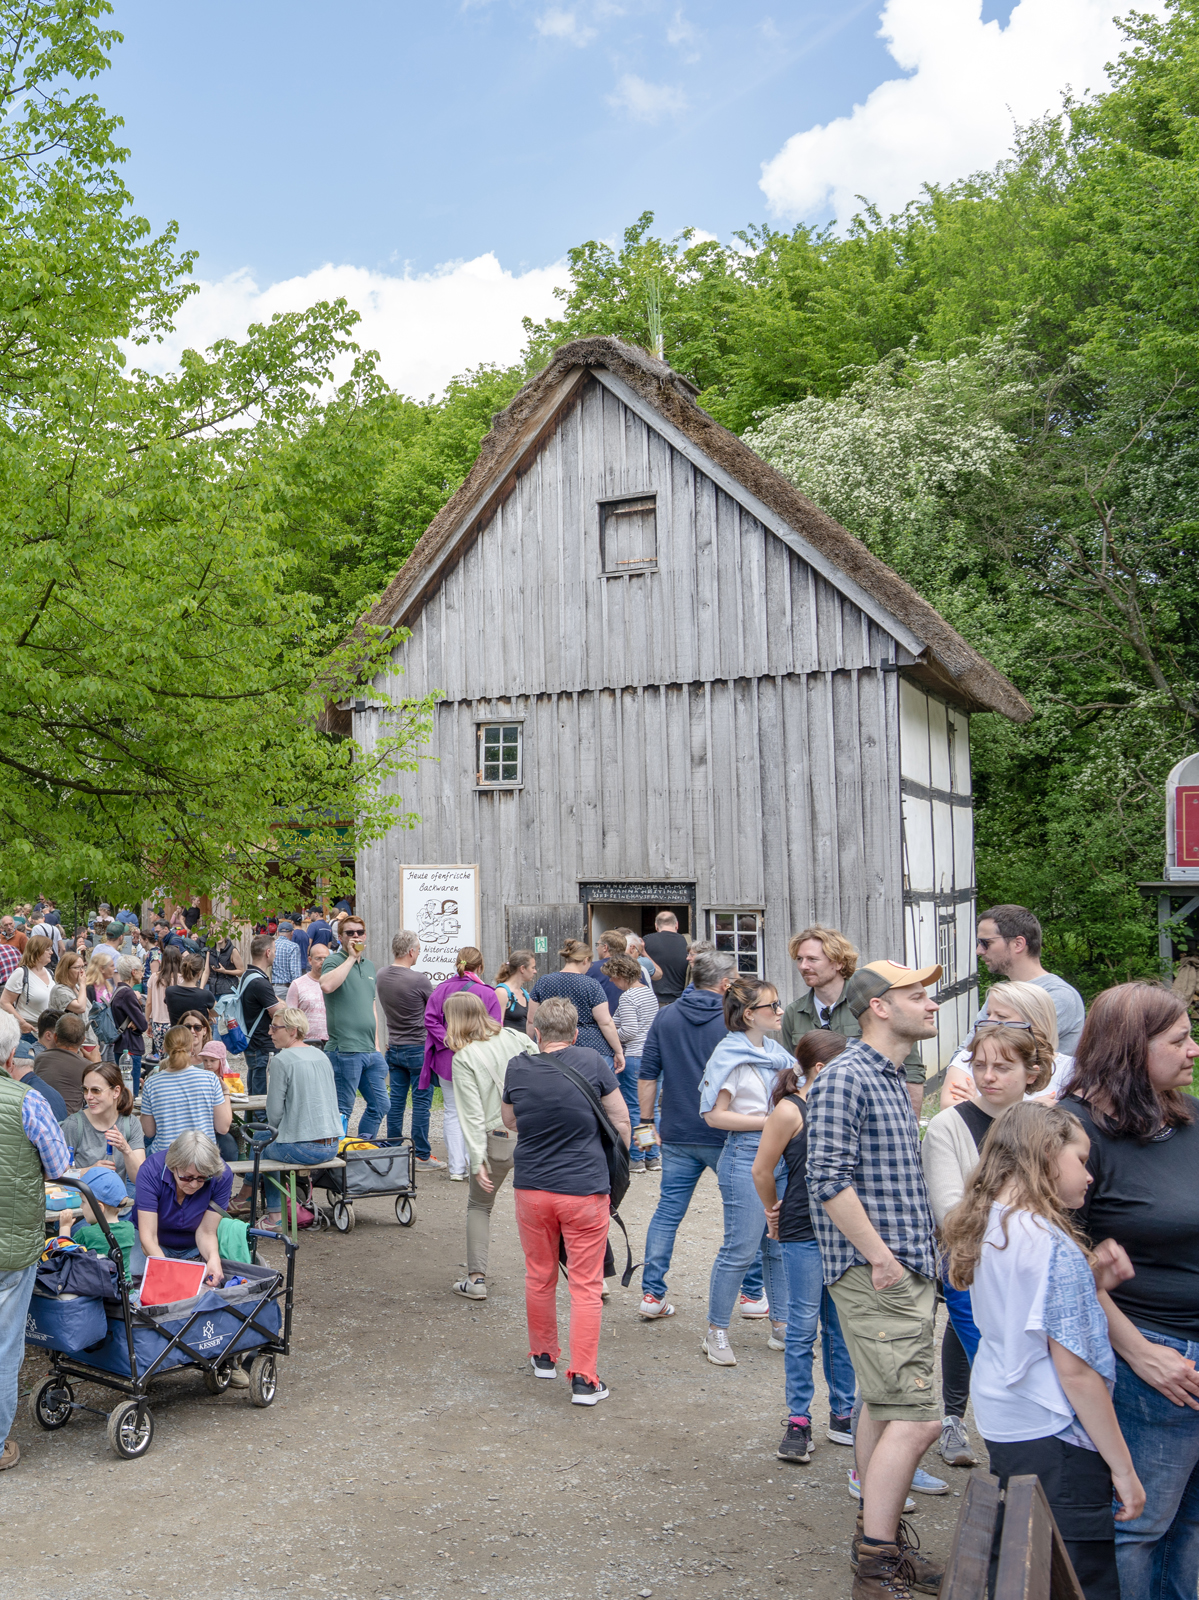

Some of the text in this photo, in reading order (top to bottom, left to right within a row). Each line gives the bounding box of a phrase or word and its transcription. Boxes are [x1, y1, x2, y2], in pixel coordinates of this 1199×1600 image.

[407, 871, 471, 881] Heute ofenfrische
[419, 883, 459, 892] Backwaren
[423, 945, 461, 954] historische
[422, 953, 456, 963] Backhaus
